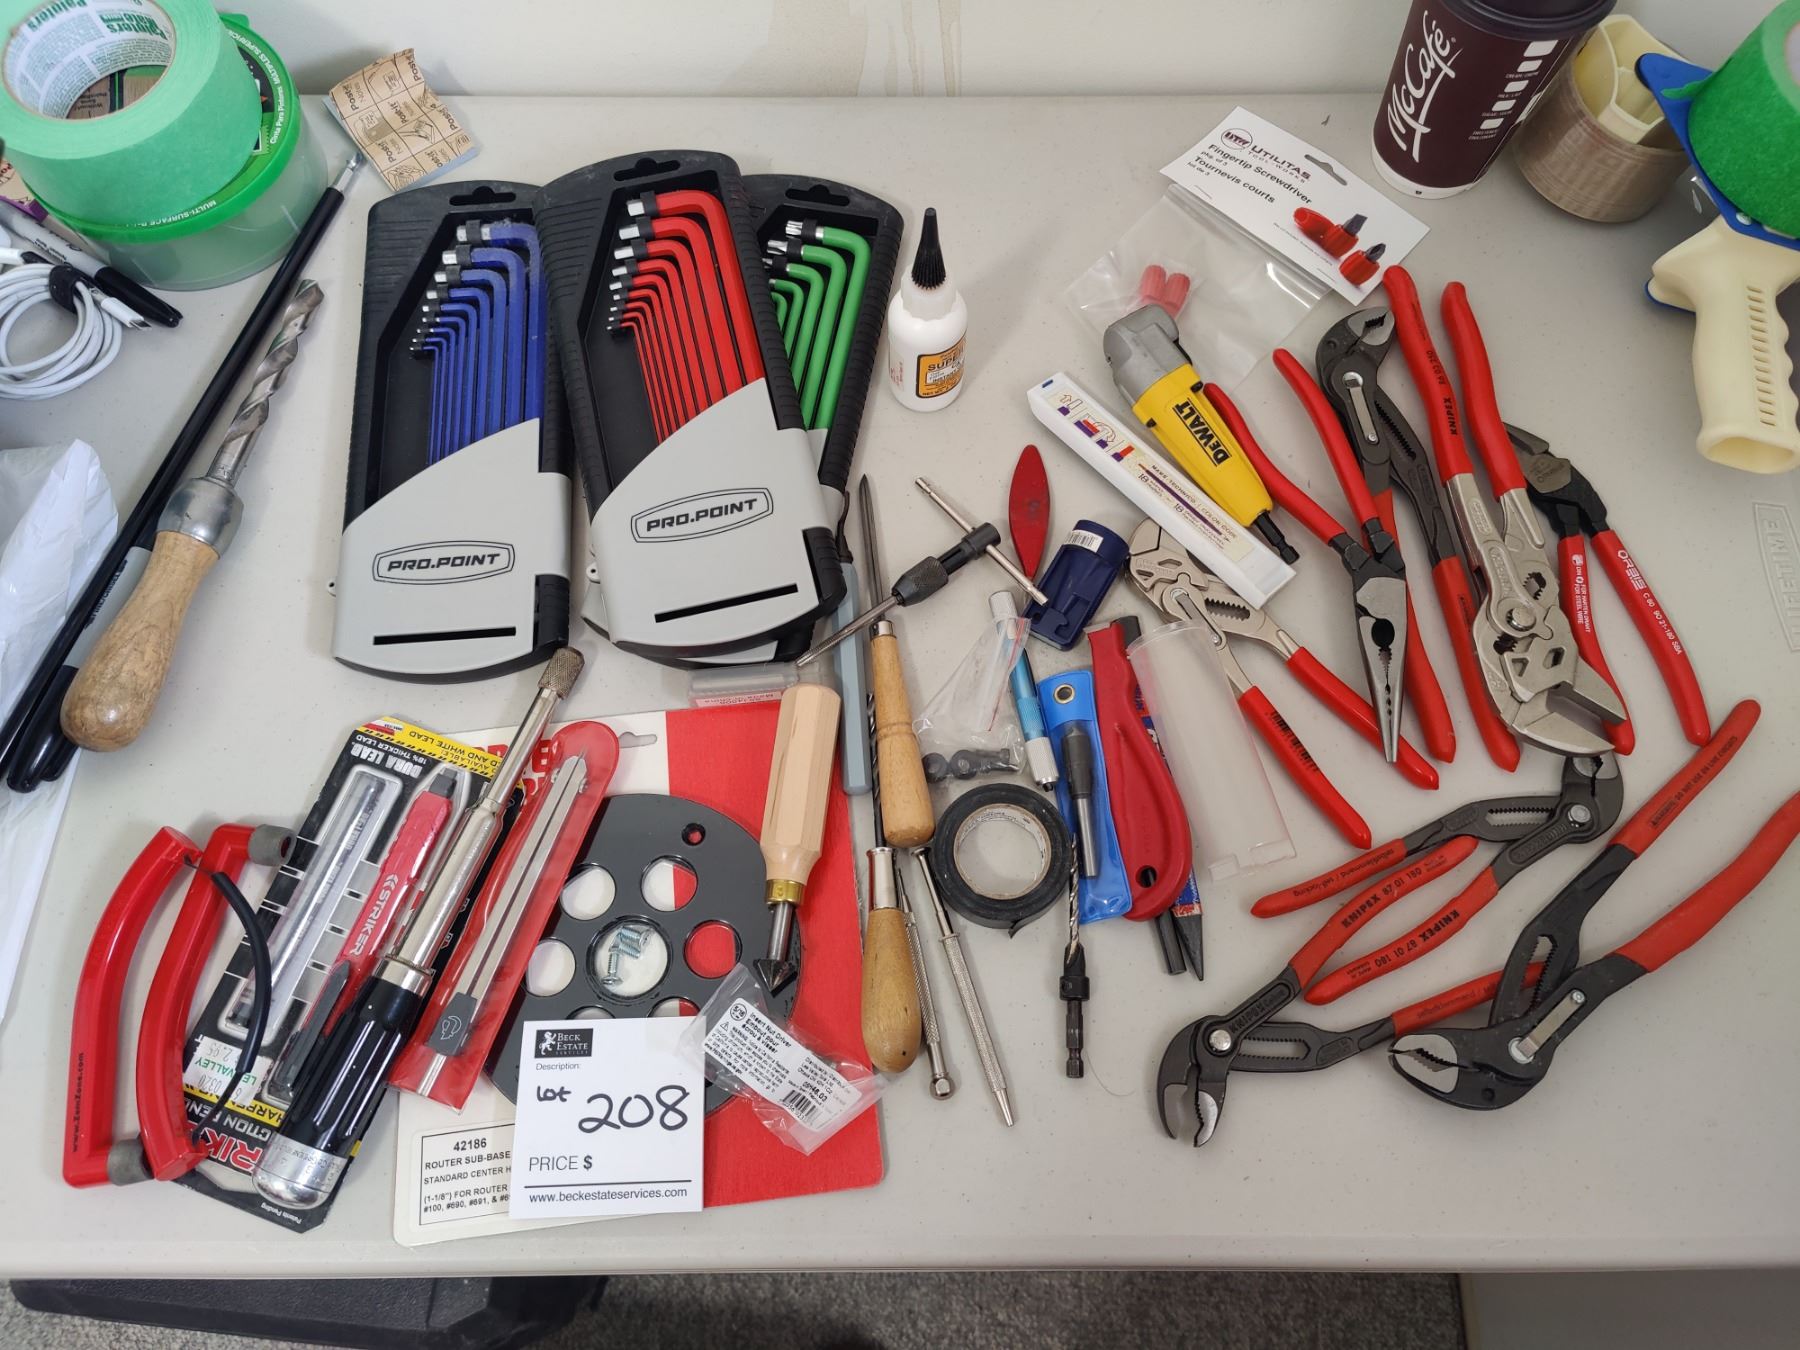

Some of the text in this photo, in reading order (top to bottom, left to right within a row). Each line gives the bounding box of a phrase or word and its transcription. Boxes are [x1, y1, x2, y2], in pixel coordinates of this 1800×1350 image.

[1251, 145, 1312, 180] UTILITAS
[1194, 156, 1275, 204] Tournevis courts
[1208, 144, 1312, 204] Fingertip Screwdriver
[1444, 397, 1458, 436] KNIPEX
[647, 498, 758, 532] PRO.POINT
[388, 552, 501, 572] PRO.POINT
[356, 734, 377, 745] LEAD
[408, 731, 435, 745] LEAD
[437, 740, 465, 755] WHITE
[378, 743, 412, 760] THICKER
[468, 752, 489, 763] AND
[385, 757, 423, 779] DURA
[1341, 867, 1422, 929] KNIPEX 87 01 180
[350, 887, 391, 956] STRIKER
[1375, 909, 1460, 968] KNIPEX 87 01 180
[557, 1033, 581, 1041] BECK
[746, 1018, 779, 1048] Embout pour
[750, 1012, 791, 1048] Insert Nut Driver
[556, 1041, 589, 1050] ESTATE
[195, 1058, 235, 1077] VALLEY
[535, 1062, 581, 1071] Description:
[578, 1084, 690, 1133] 208
[453, 1138, 487, 1152] 42186
[425, 1151, 511, 1170] ROUTER SUB-BASE
[528, 1155, 593, 1172] PRICE $
[424, 1172, 468, 1185] STANDARD
[470, 1168, 503, 1179] CENTER
[454, 1189, 471, 1198] FOR
[473, 1184, 508, 1196] ROUTER
[529, 1187, 688, 1203] www.beckestateservices.com
[260, 1201, 282, 1218] Pending
